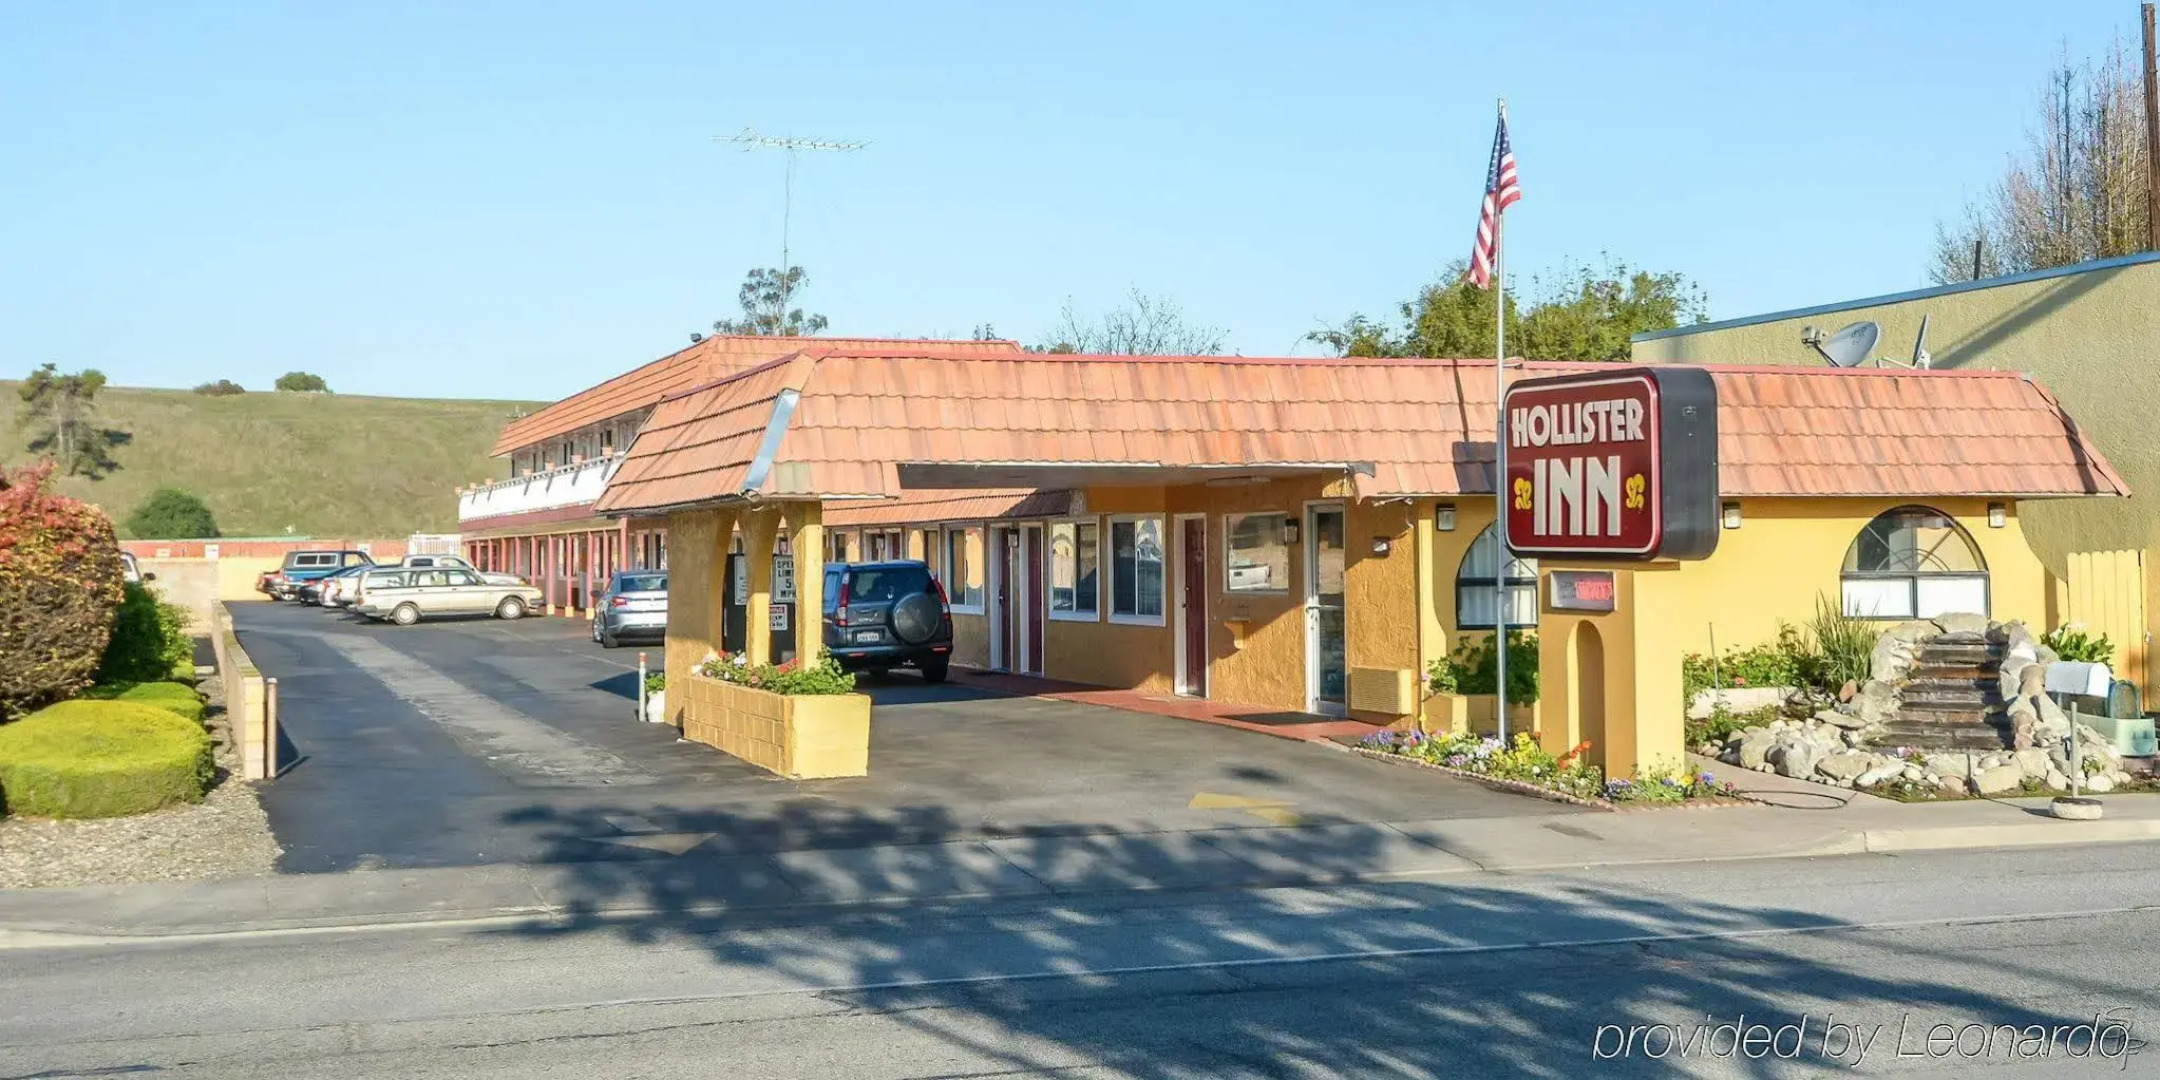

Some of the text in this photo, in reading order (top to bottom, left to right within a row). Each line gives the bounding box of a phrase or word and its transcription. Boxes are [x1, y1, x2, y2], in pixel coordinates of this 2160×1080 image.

[1511, 397, 1645, 448] HOLLISTER
[1533, 455, 1621, 536] INN
[777, 560, 794, 569] SPE
[778, 569, 794, 578] LIMI
[785, 578, 792, 589] 5
